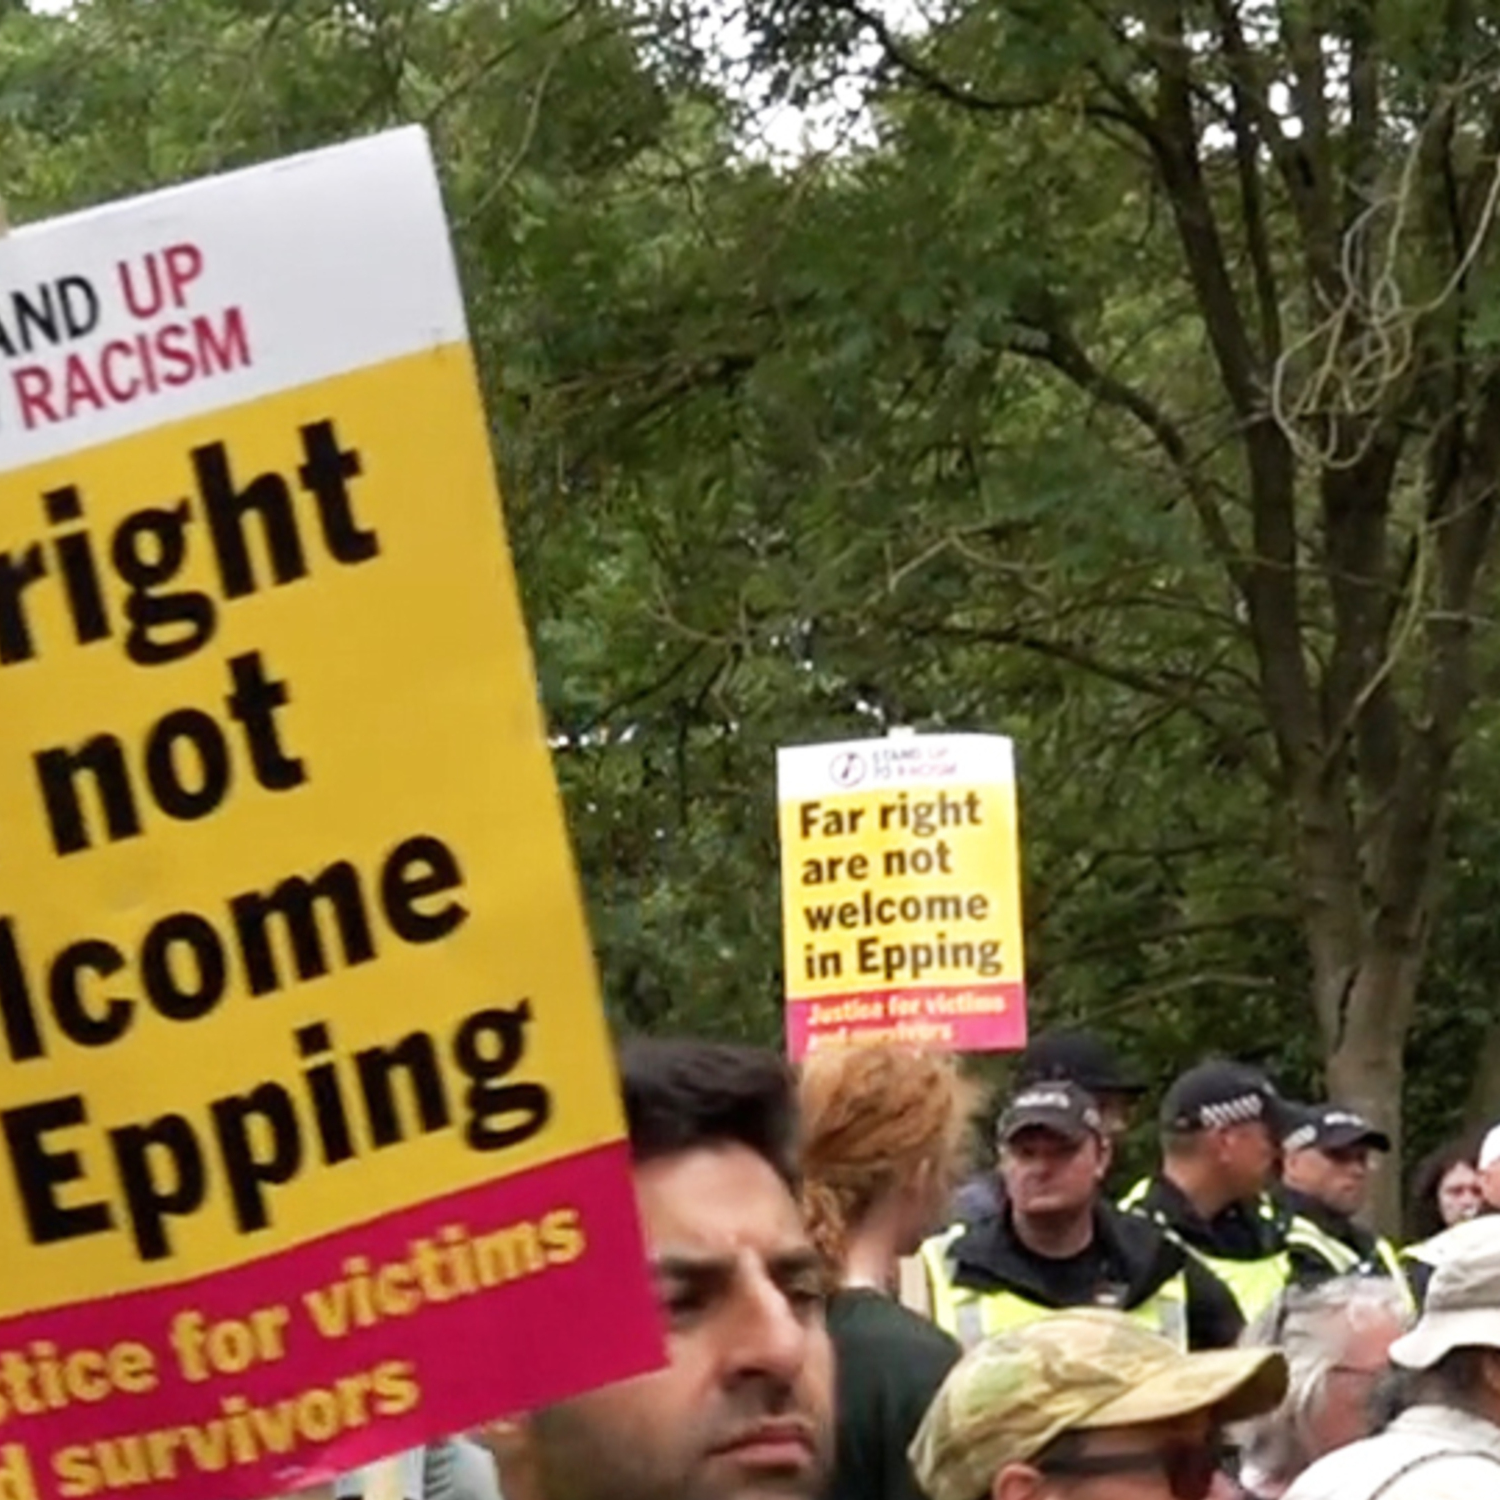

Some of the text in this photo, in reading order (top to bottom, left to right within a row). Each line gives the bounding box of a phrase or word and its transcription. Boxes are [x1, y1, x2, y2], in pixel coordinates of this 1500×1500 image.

[117, 242, 206, 322] UP
[10, 307, 252, 431] RACISM
[34, 650, 310, 856] not
[799, 790, 982, 840] Far right
[801, 840, 953, 887] are not
[803, 890, 990, 932] welcome
[805, 931, 1003, 981] in Epping
[170, 1299, 290, 1385] for
[304, 1206, 586, 1340] victims
[52, 1354, 420, 1499] survivors
